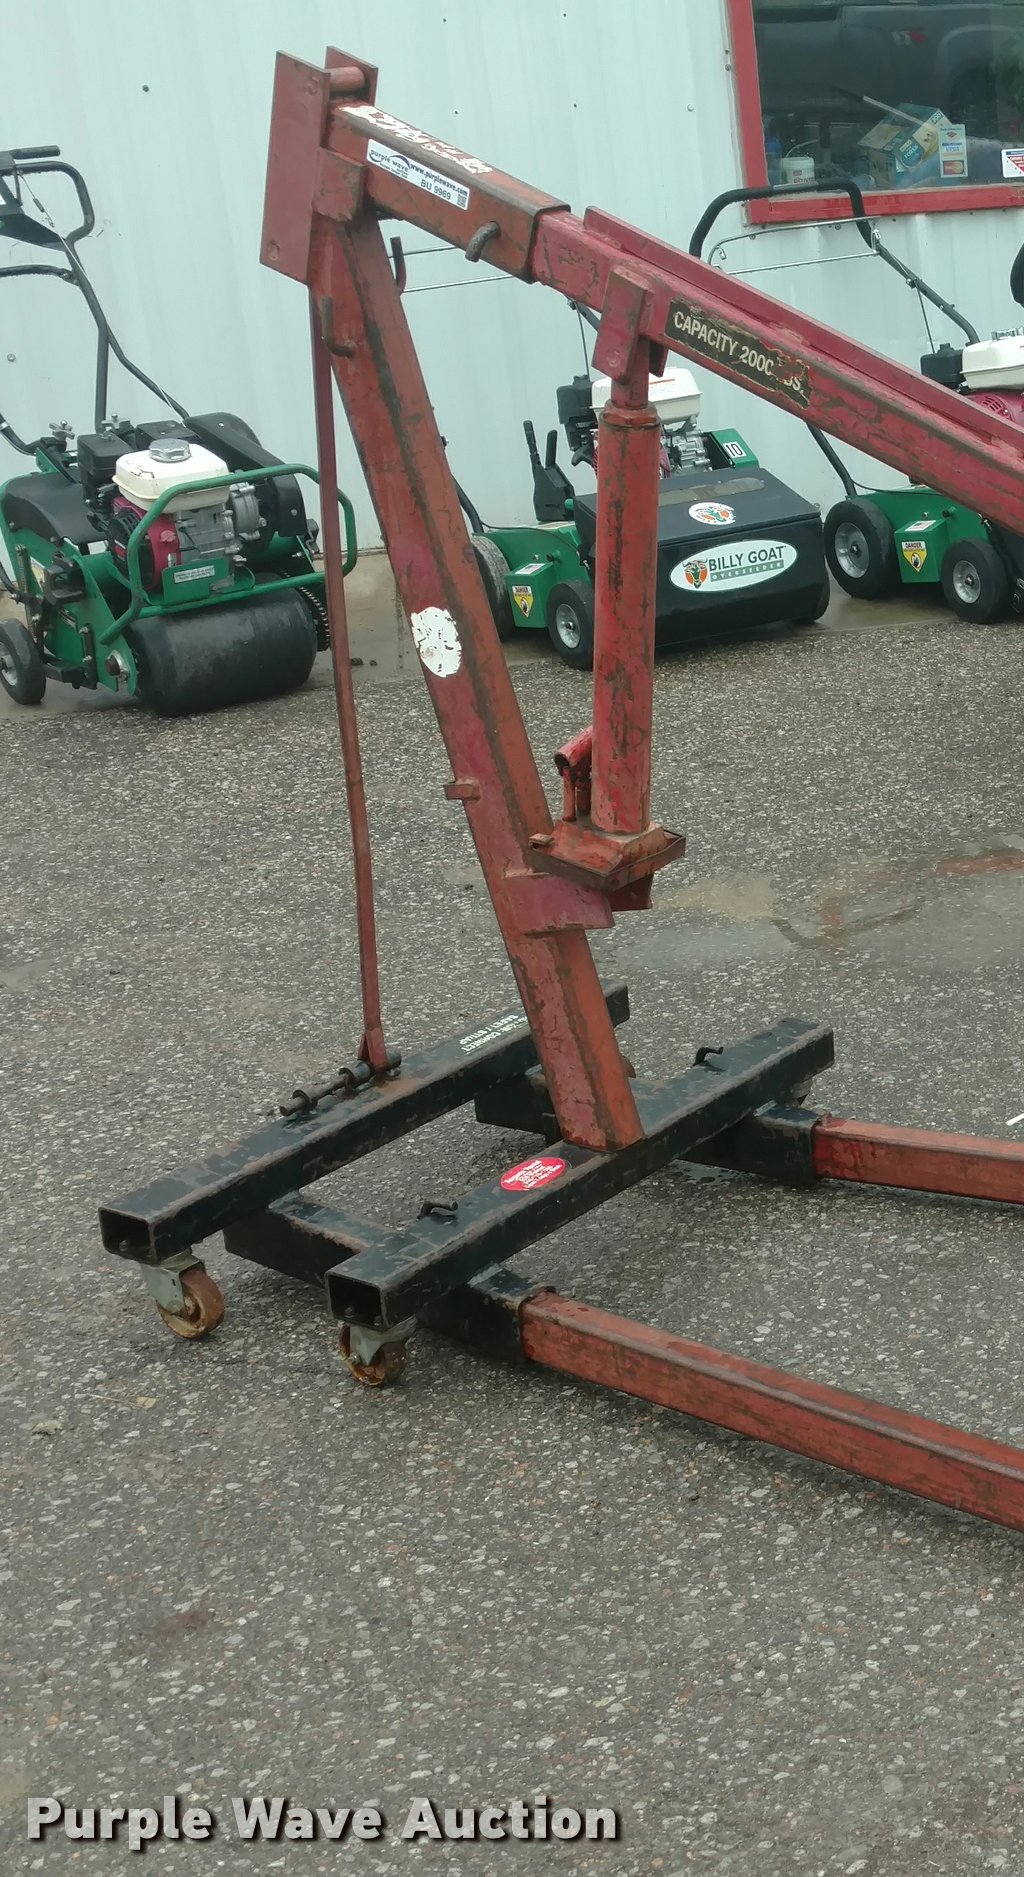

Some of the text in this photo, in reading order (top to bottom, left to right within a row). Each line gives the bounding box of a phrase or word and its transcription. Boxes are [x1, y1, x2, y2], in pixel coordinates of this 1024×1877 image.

[370, 150, 391, 164] purple
[391, 161, 409, 172] wave
[410, 163, 468, 197] www.purplewave.com
[420, 179, 451, 200] BU 9969
[674, 311, 738, 356] CAPACITY
[726, 443, 743, 458] 10
[708, 546, 784, 572] BILLY GOAT
